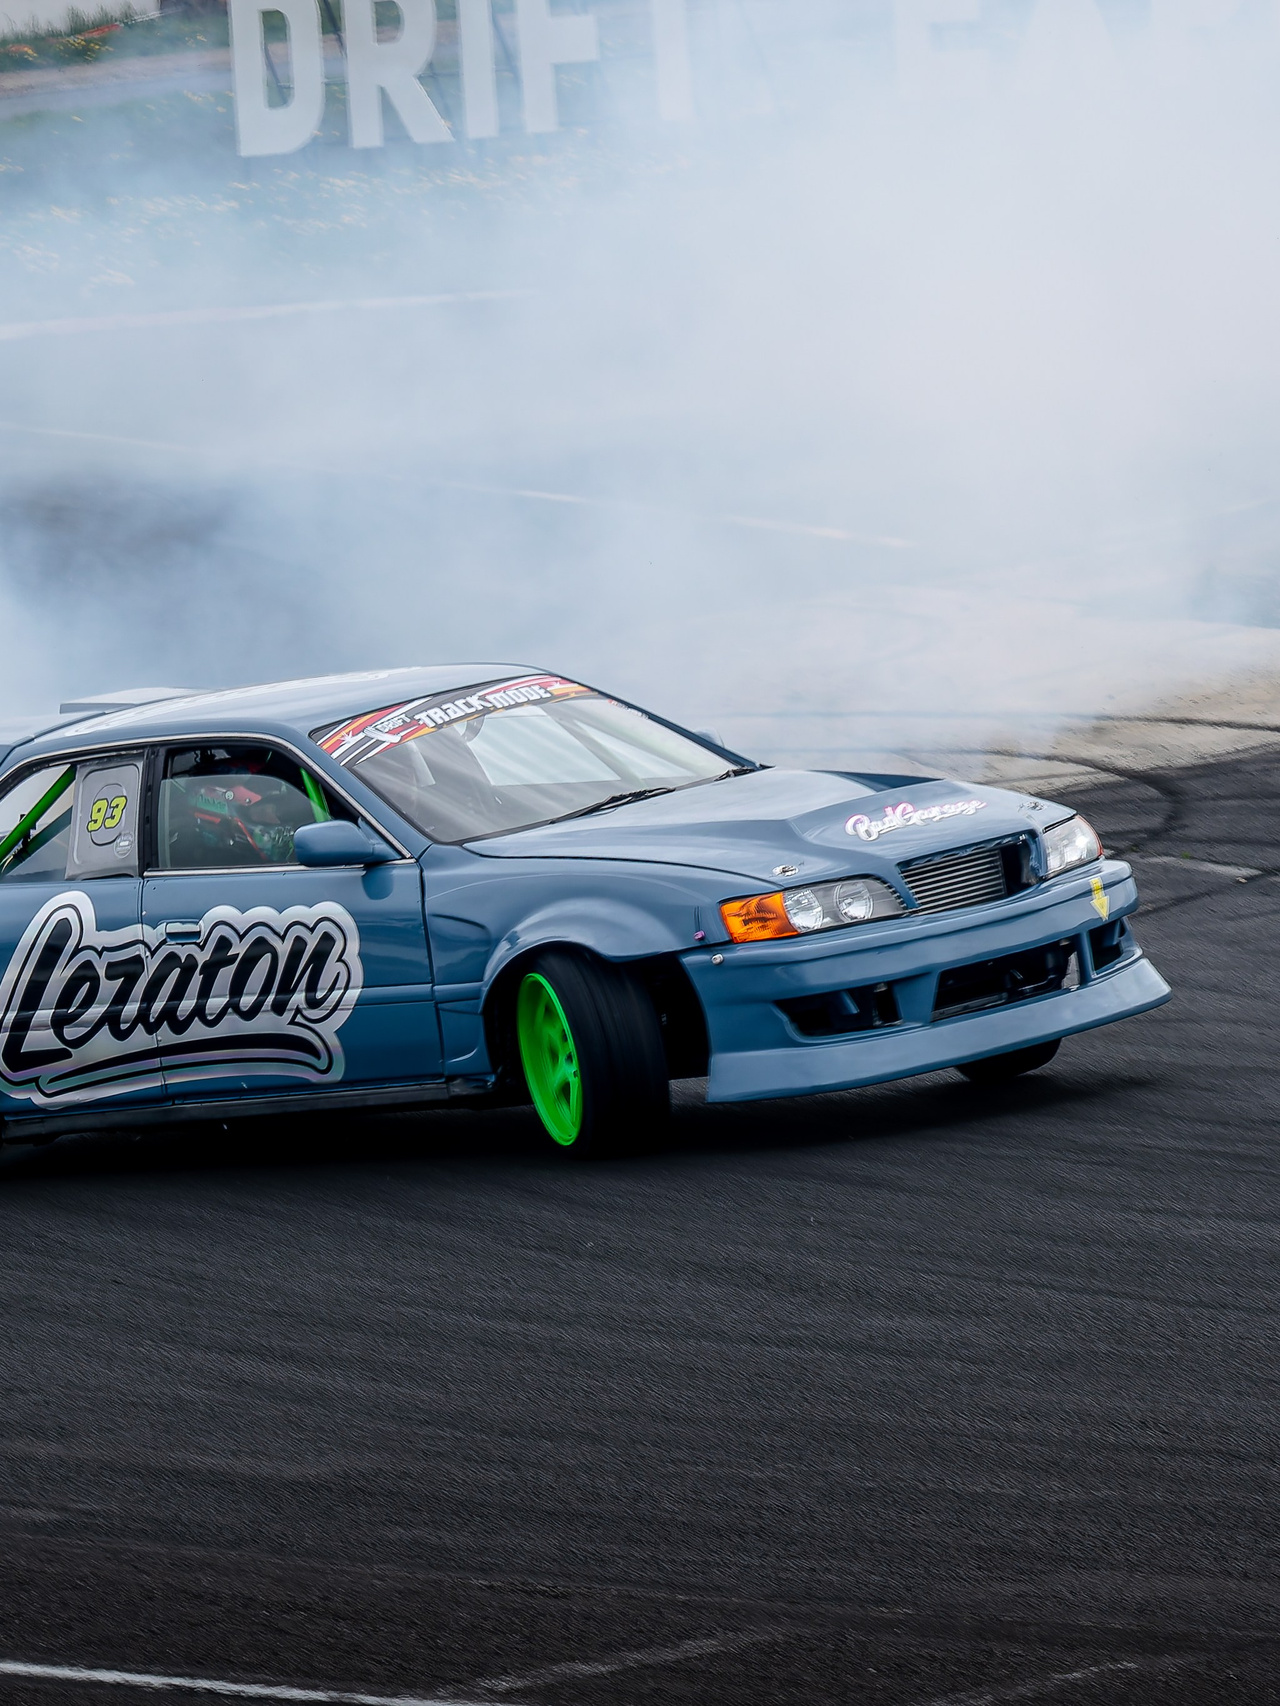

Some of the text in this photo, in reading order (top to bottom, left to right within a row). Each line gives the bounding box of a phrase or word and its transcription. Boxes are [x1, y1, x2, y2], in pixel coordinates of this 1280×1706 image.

[379, 713, 411, 734] DRIFT
[414, 684, 552, 728] TRACK MODE
[87, 795, 128, 833] 93
